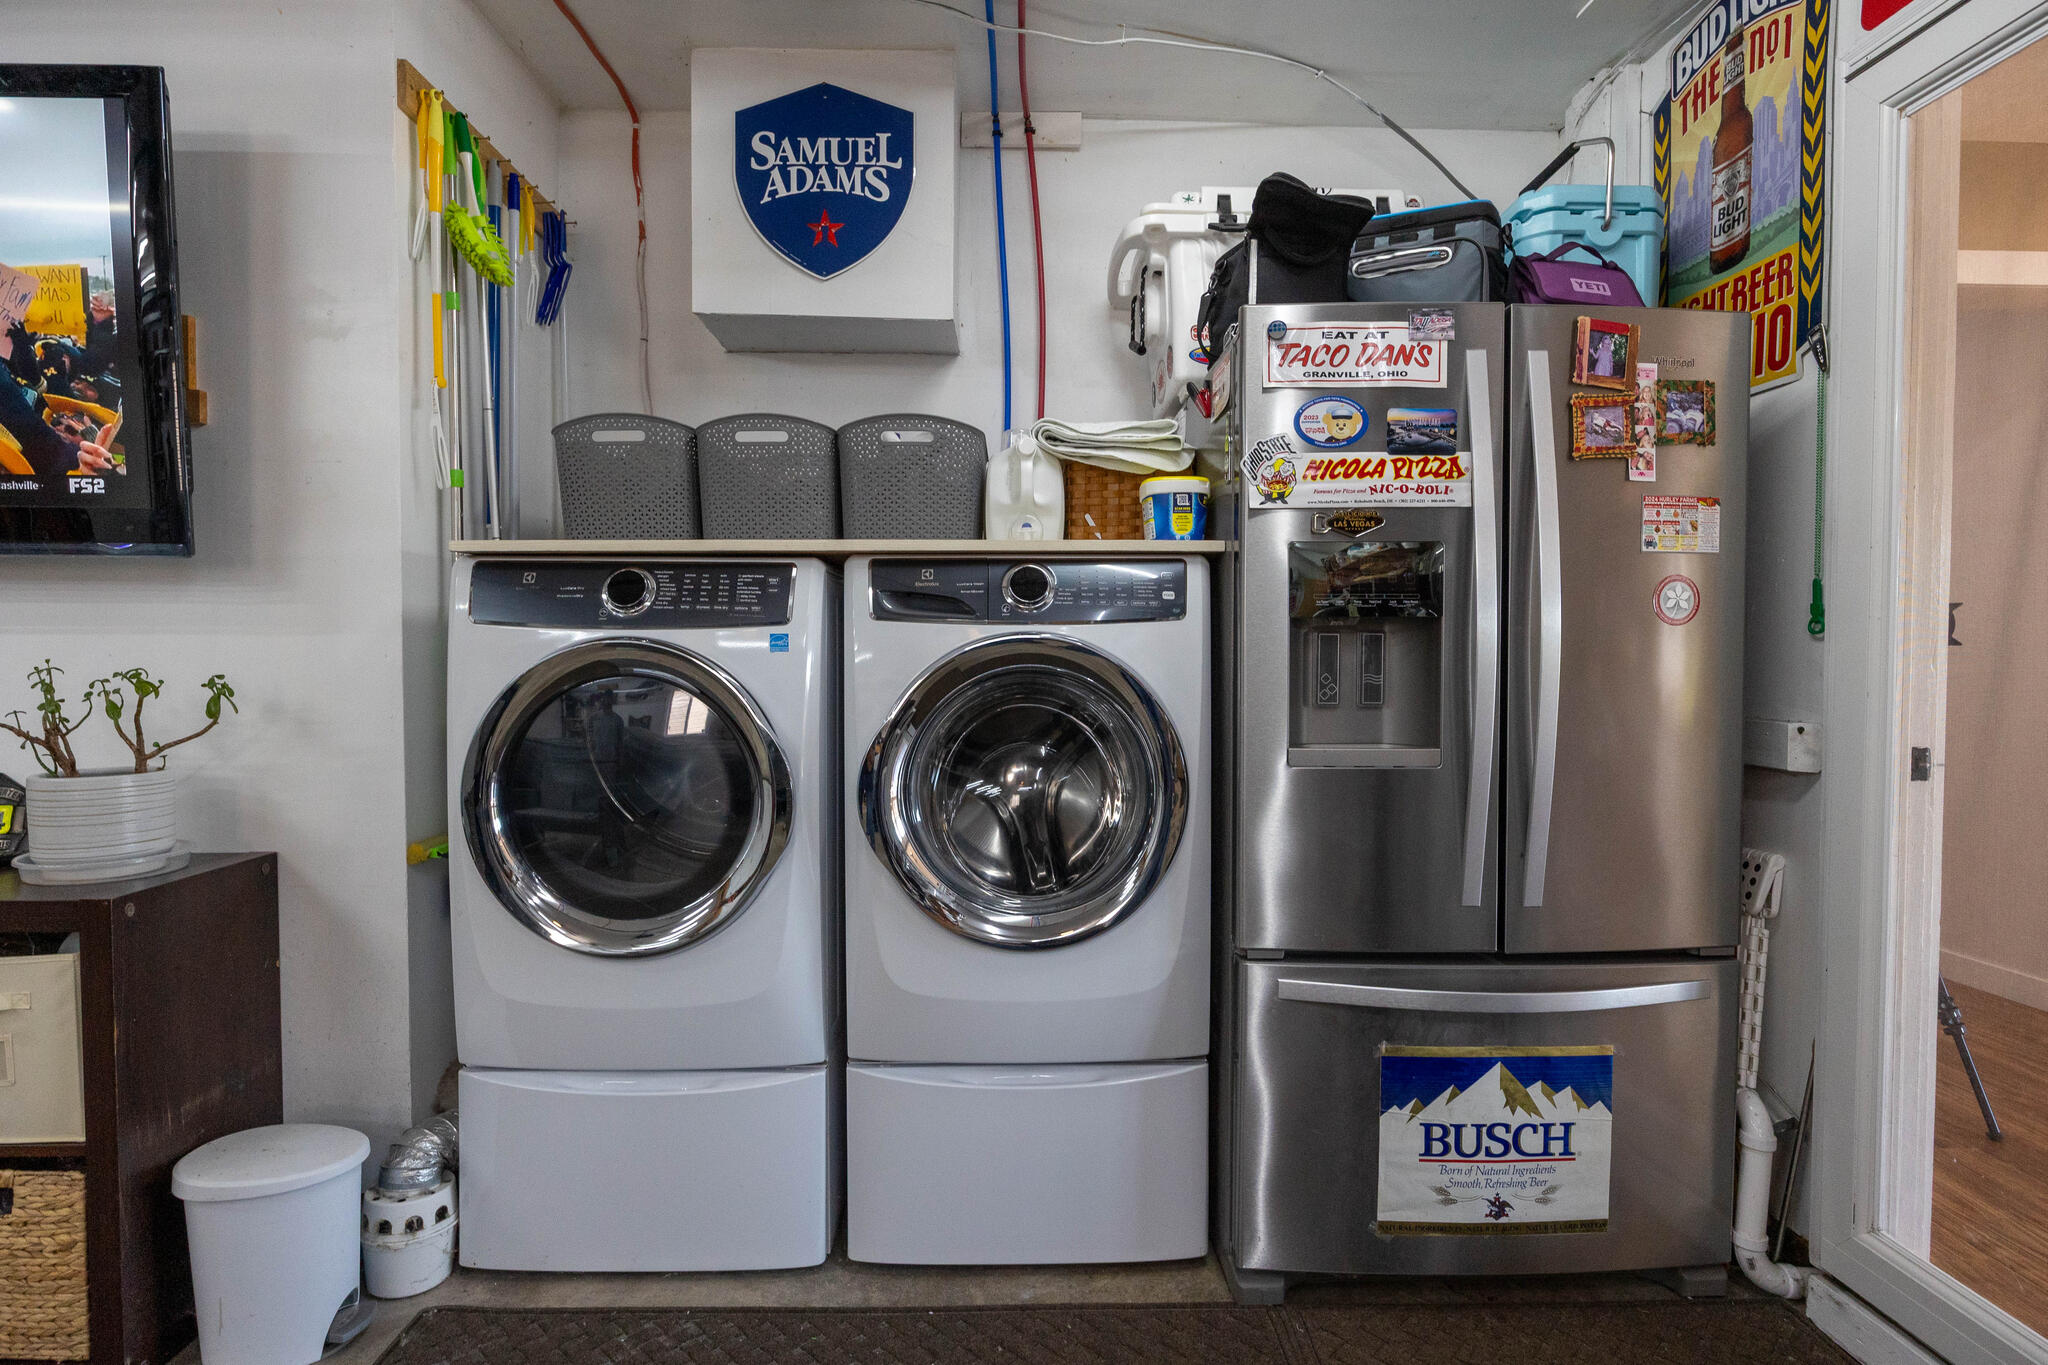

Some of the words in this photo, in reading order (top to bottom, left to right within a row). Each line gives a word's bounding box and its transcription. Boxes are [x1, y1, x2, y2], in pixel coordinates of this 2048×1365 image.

[1676, 5, 1727, 93] BUD
[1679, 57, 1720, 136] THE
[750, 131, 903, 170] SAMUEL
[760, 165, 890, 205] ADAMS
[1718, 196, 1744, 222] BUD
[1713, 207, 1748, 239] LIGHT
[36, 286, 70, 302] MAS
[1574, 280, 1607, 292] YETI
[1731, 252, 1795, 314] BEER
[1321, 331, 1358, 340] EAT
[1364, 331, 1389, 340] AT
[1277, 342, 1350, 368] TACO
[1355, 342, 1433, 368] DAN'S
[1650, 356, 1695, 369] Whirlpool
[1302, 371, 1374, 379] GRANVILLE,
[1378, 370, 1408, 378] OHIO
[1242, 447, 1265, 481] OHIO
[1257, 435, 1297, 461] STATE
[1302, 457, 1388, 481] NICOLA
[1388, 456, 1467, 481] PIZZA
[0, 481, 39, 490] ashville
[69, 478, 105, 494] FS2
[1350, 520, 1376, 528] VEGAS
[1418, 1121, 1577, 1159] BUSCH
[1438, 1164, 1462, 1176] Born
[1464, 1165, 1473, 1177] of
[1475, 1164, 1510, 1176] Natural
[1512, 1164, 1557, 1177] Ingredients
[1445, 1177, 1483, 1190] Smooth,
[1485, 1176, 1528, 1189] Refreshing
[1529, 1176, 1549, 1187] Beer
